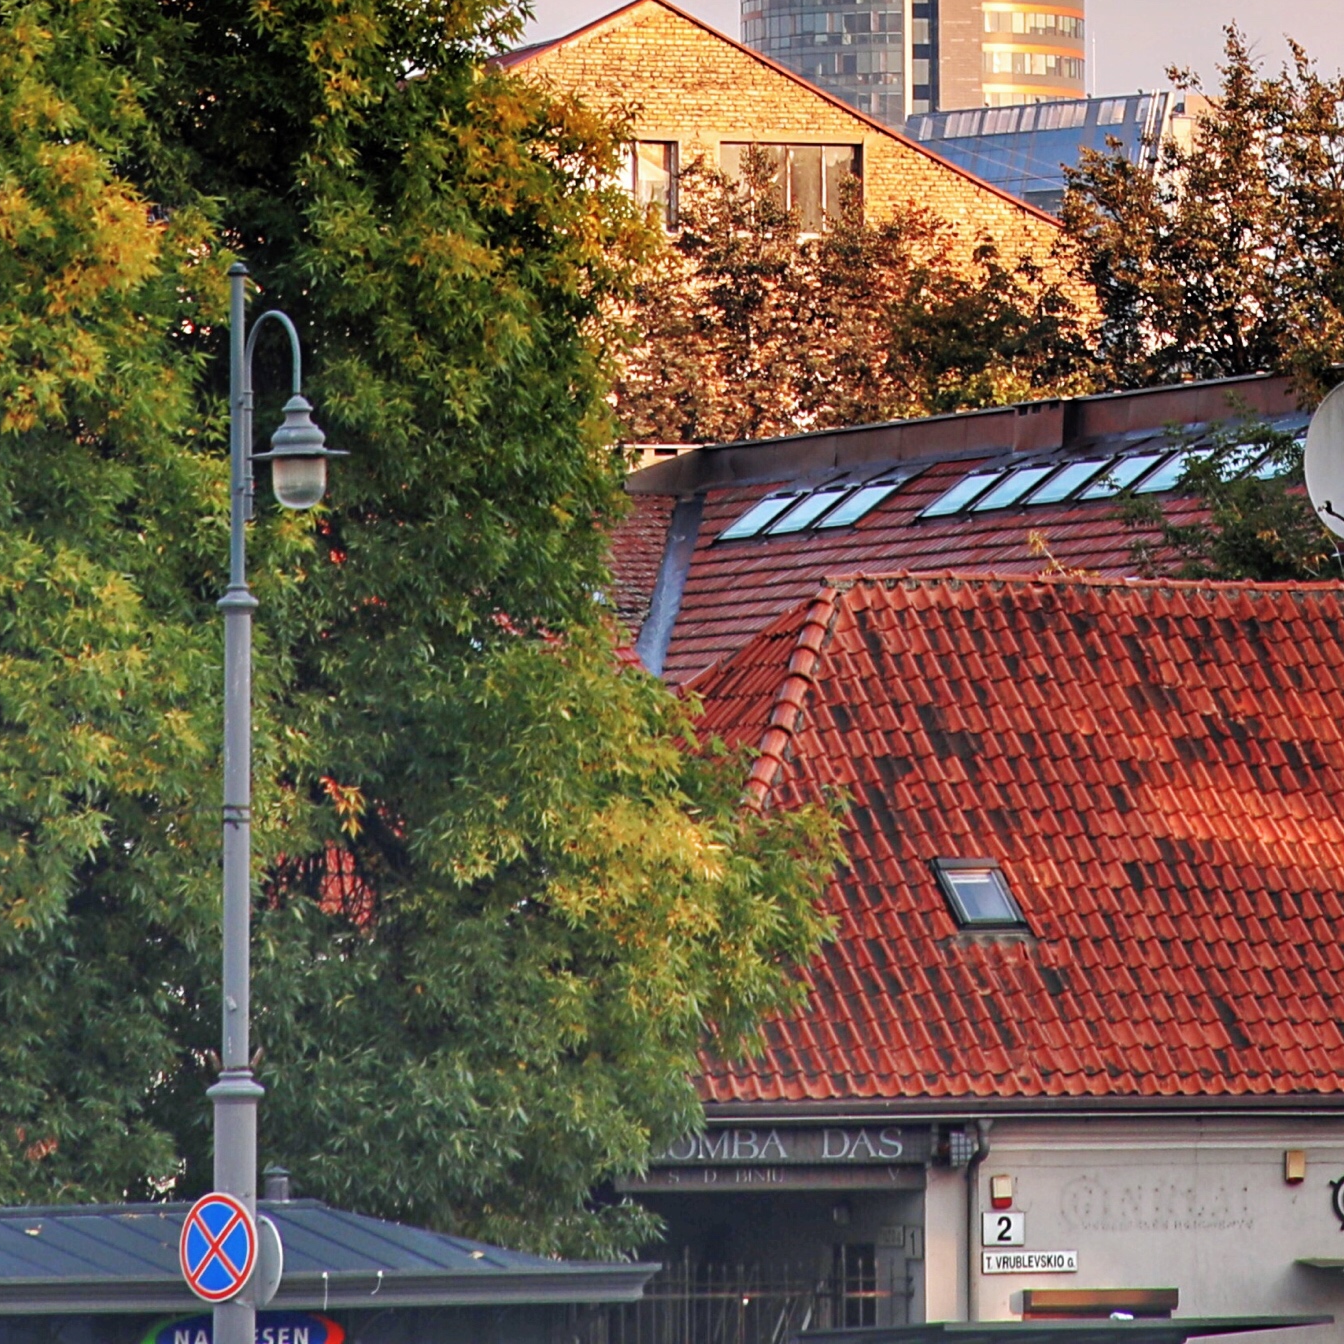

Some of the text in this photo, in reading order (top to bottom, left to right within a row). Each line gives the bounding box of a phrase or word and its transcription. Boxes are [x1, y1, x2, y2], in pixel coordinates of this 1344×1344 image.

[655, 1127, 789, 1160] OMBA
[996, 1216, 1012, 1242] 2
[996, 1254, 1065, 1269] VRUBLEVSKIO
